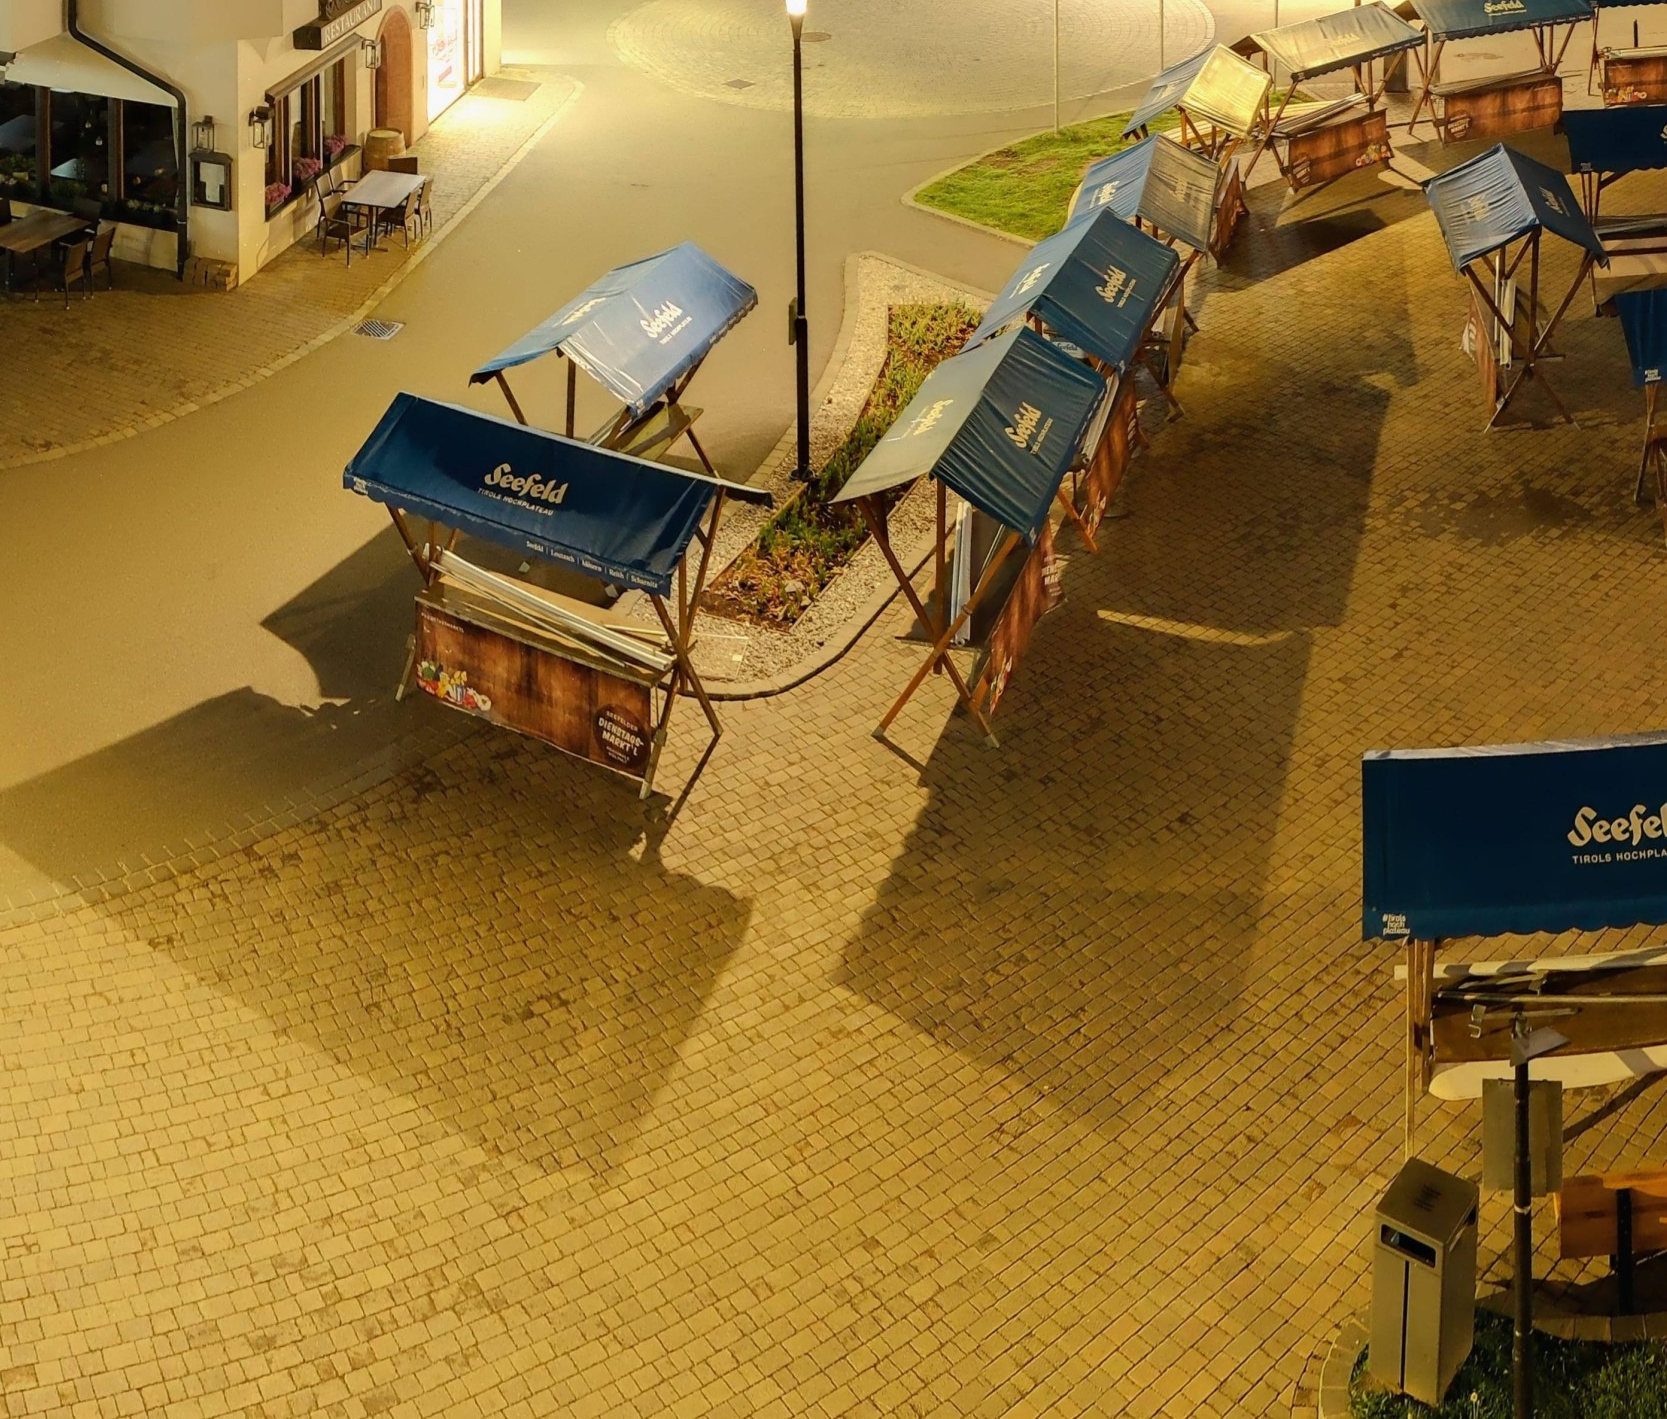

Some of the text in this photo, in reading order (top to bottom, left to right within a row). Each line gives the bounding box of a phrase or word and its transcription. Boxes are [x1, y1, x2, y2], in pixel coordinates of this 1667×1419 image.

[484, 462, 569, 505] Seefeld
[598, 717, 644, 746] DIENSTAGS-
[1572, 852, 1612, 865] TIROLS
